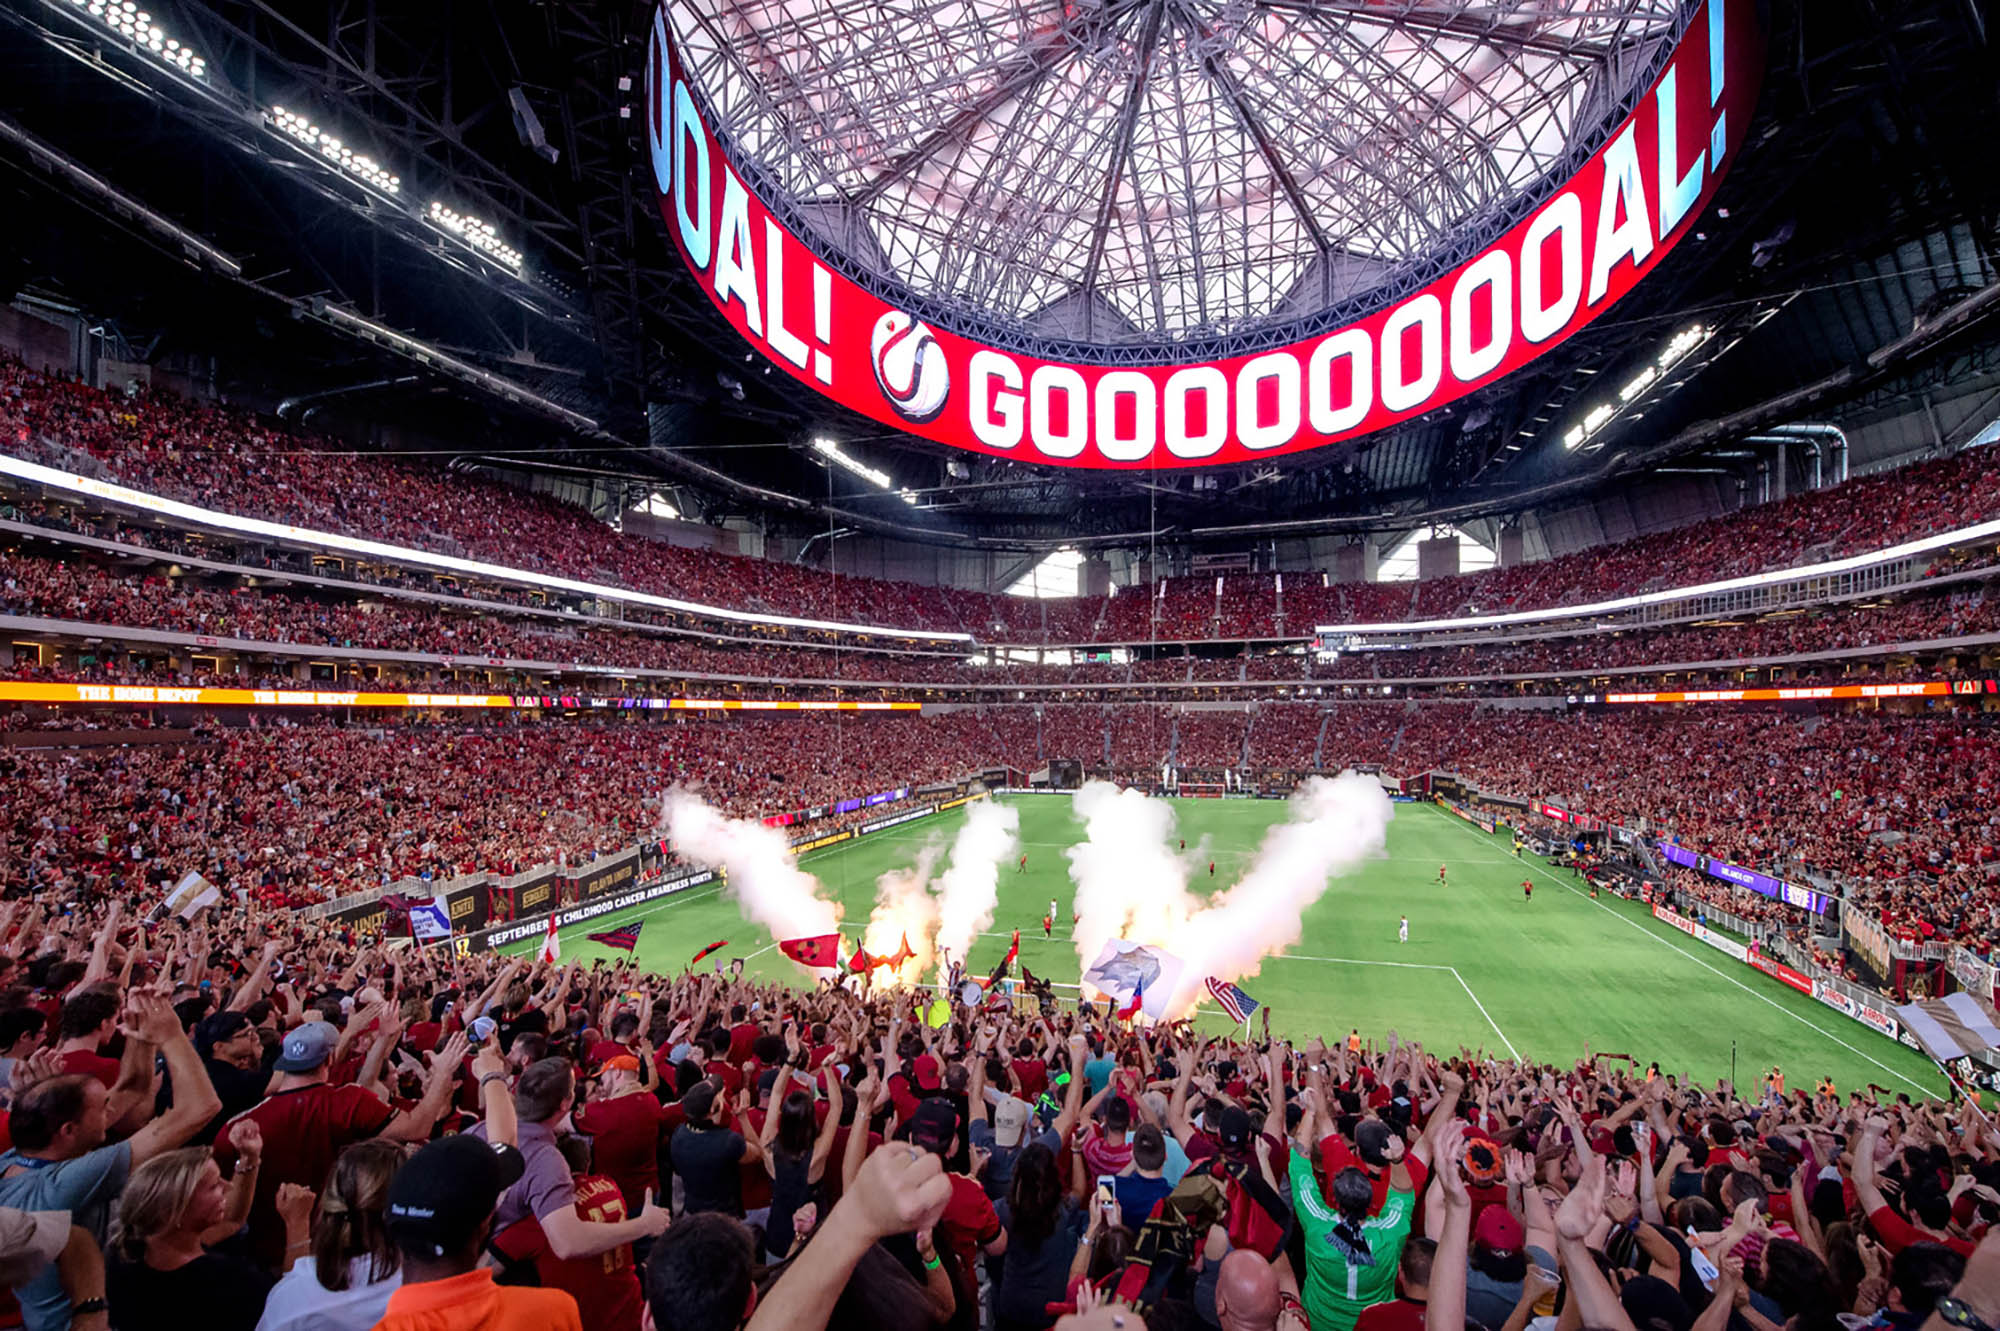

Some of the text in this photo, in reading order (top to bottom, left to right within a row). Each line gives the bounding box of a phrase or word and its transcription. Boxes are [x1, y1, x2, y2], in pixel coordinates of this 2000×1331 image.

[78, 686, 201, 702] THE HOME DEPOT
[487, 919, 550, 947] SEPTEMBER
[563, 899, 615, 926] CHILDHOOD
[614, 890, 647, 910] CANCER
[646, 877, 690, 899] AWARENESS
[689, 871, 714, 887] MONTH
[1862, 1006, 1888, 1028] ARROW
